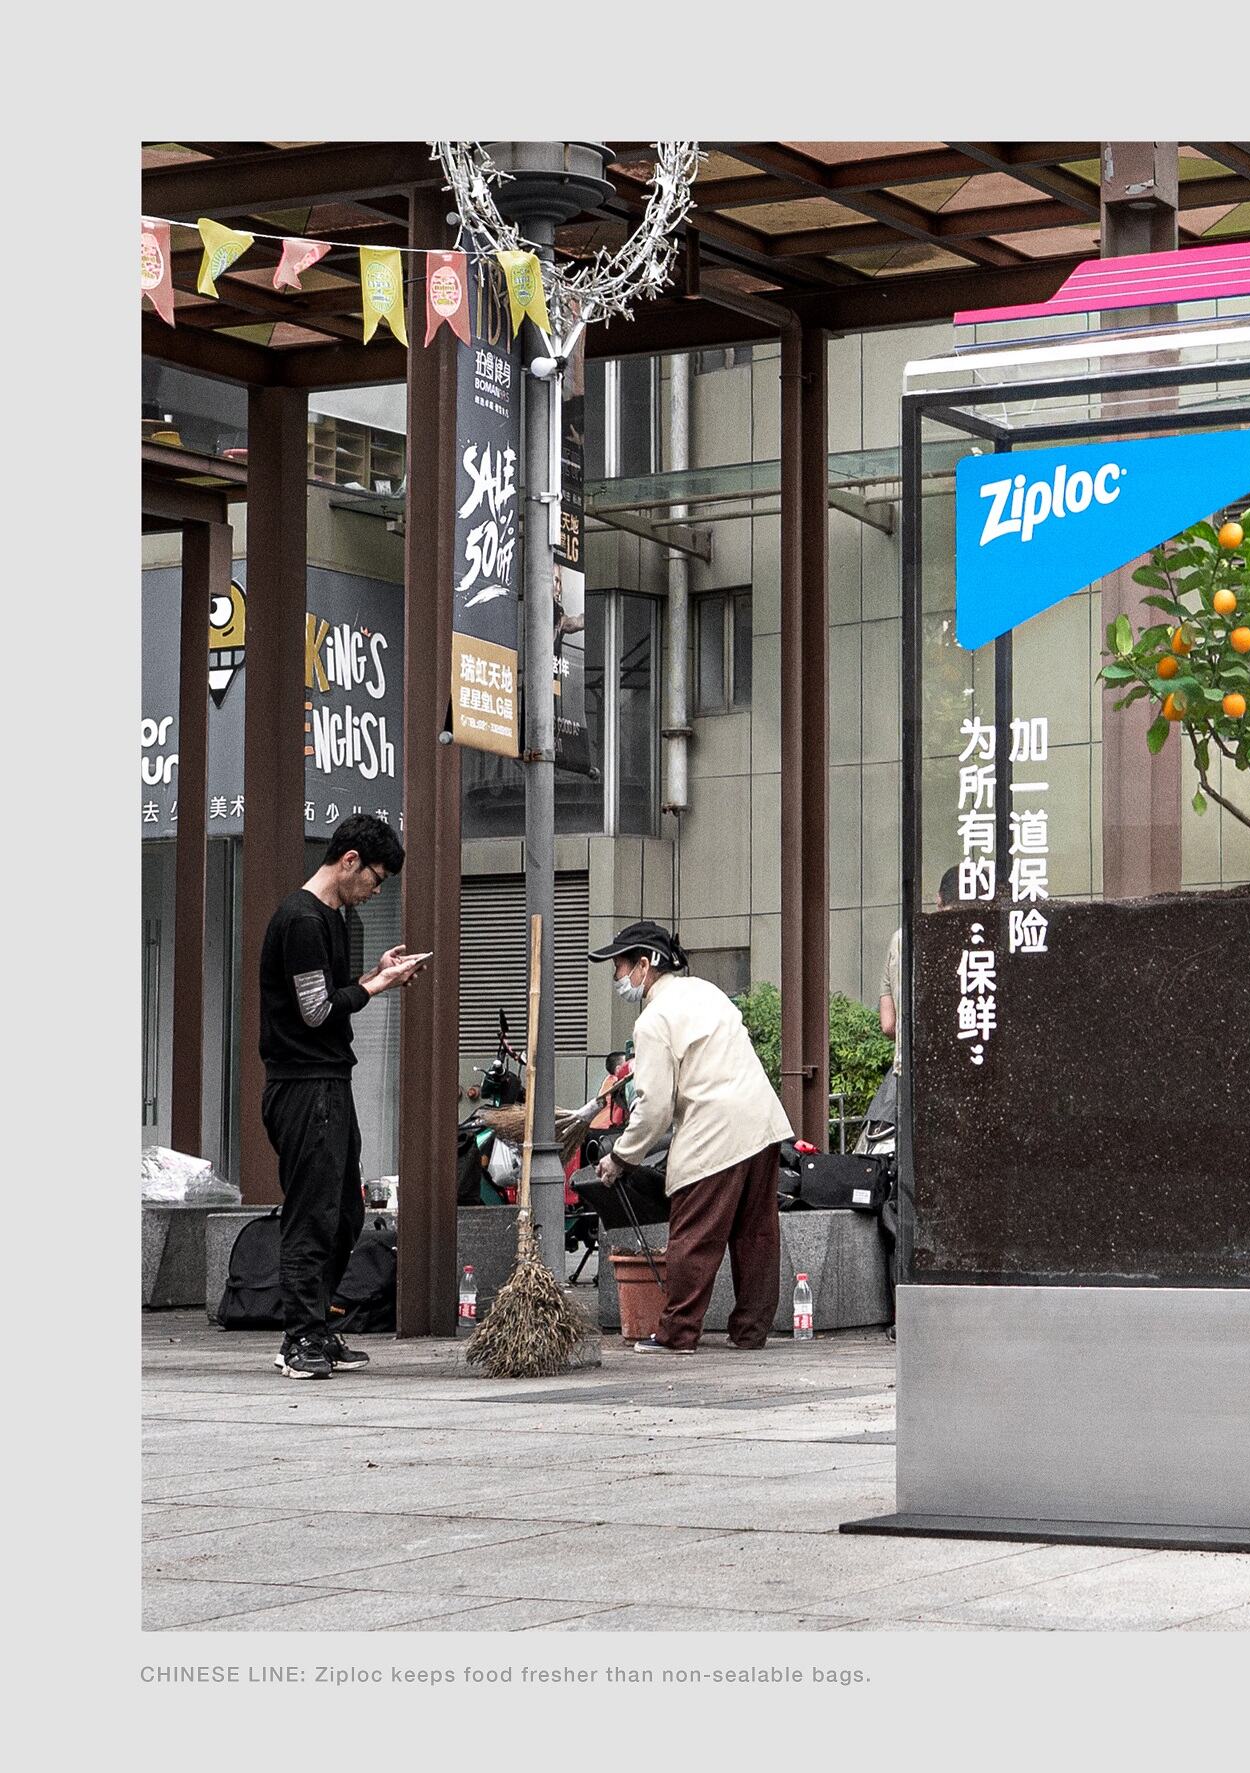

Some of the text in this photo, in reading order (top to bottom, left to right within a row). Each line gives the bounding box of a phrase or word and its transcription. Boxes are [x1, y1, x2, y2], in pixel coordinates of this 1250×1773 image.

[458, 440, 517, 522] SALE
[979, 463, 1127, 547] Ziploc
[460, 653, 513, 693] 瑞虹天地
[1008, 717, 1049, 954] 加一道保险
